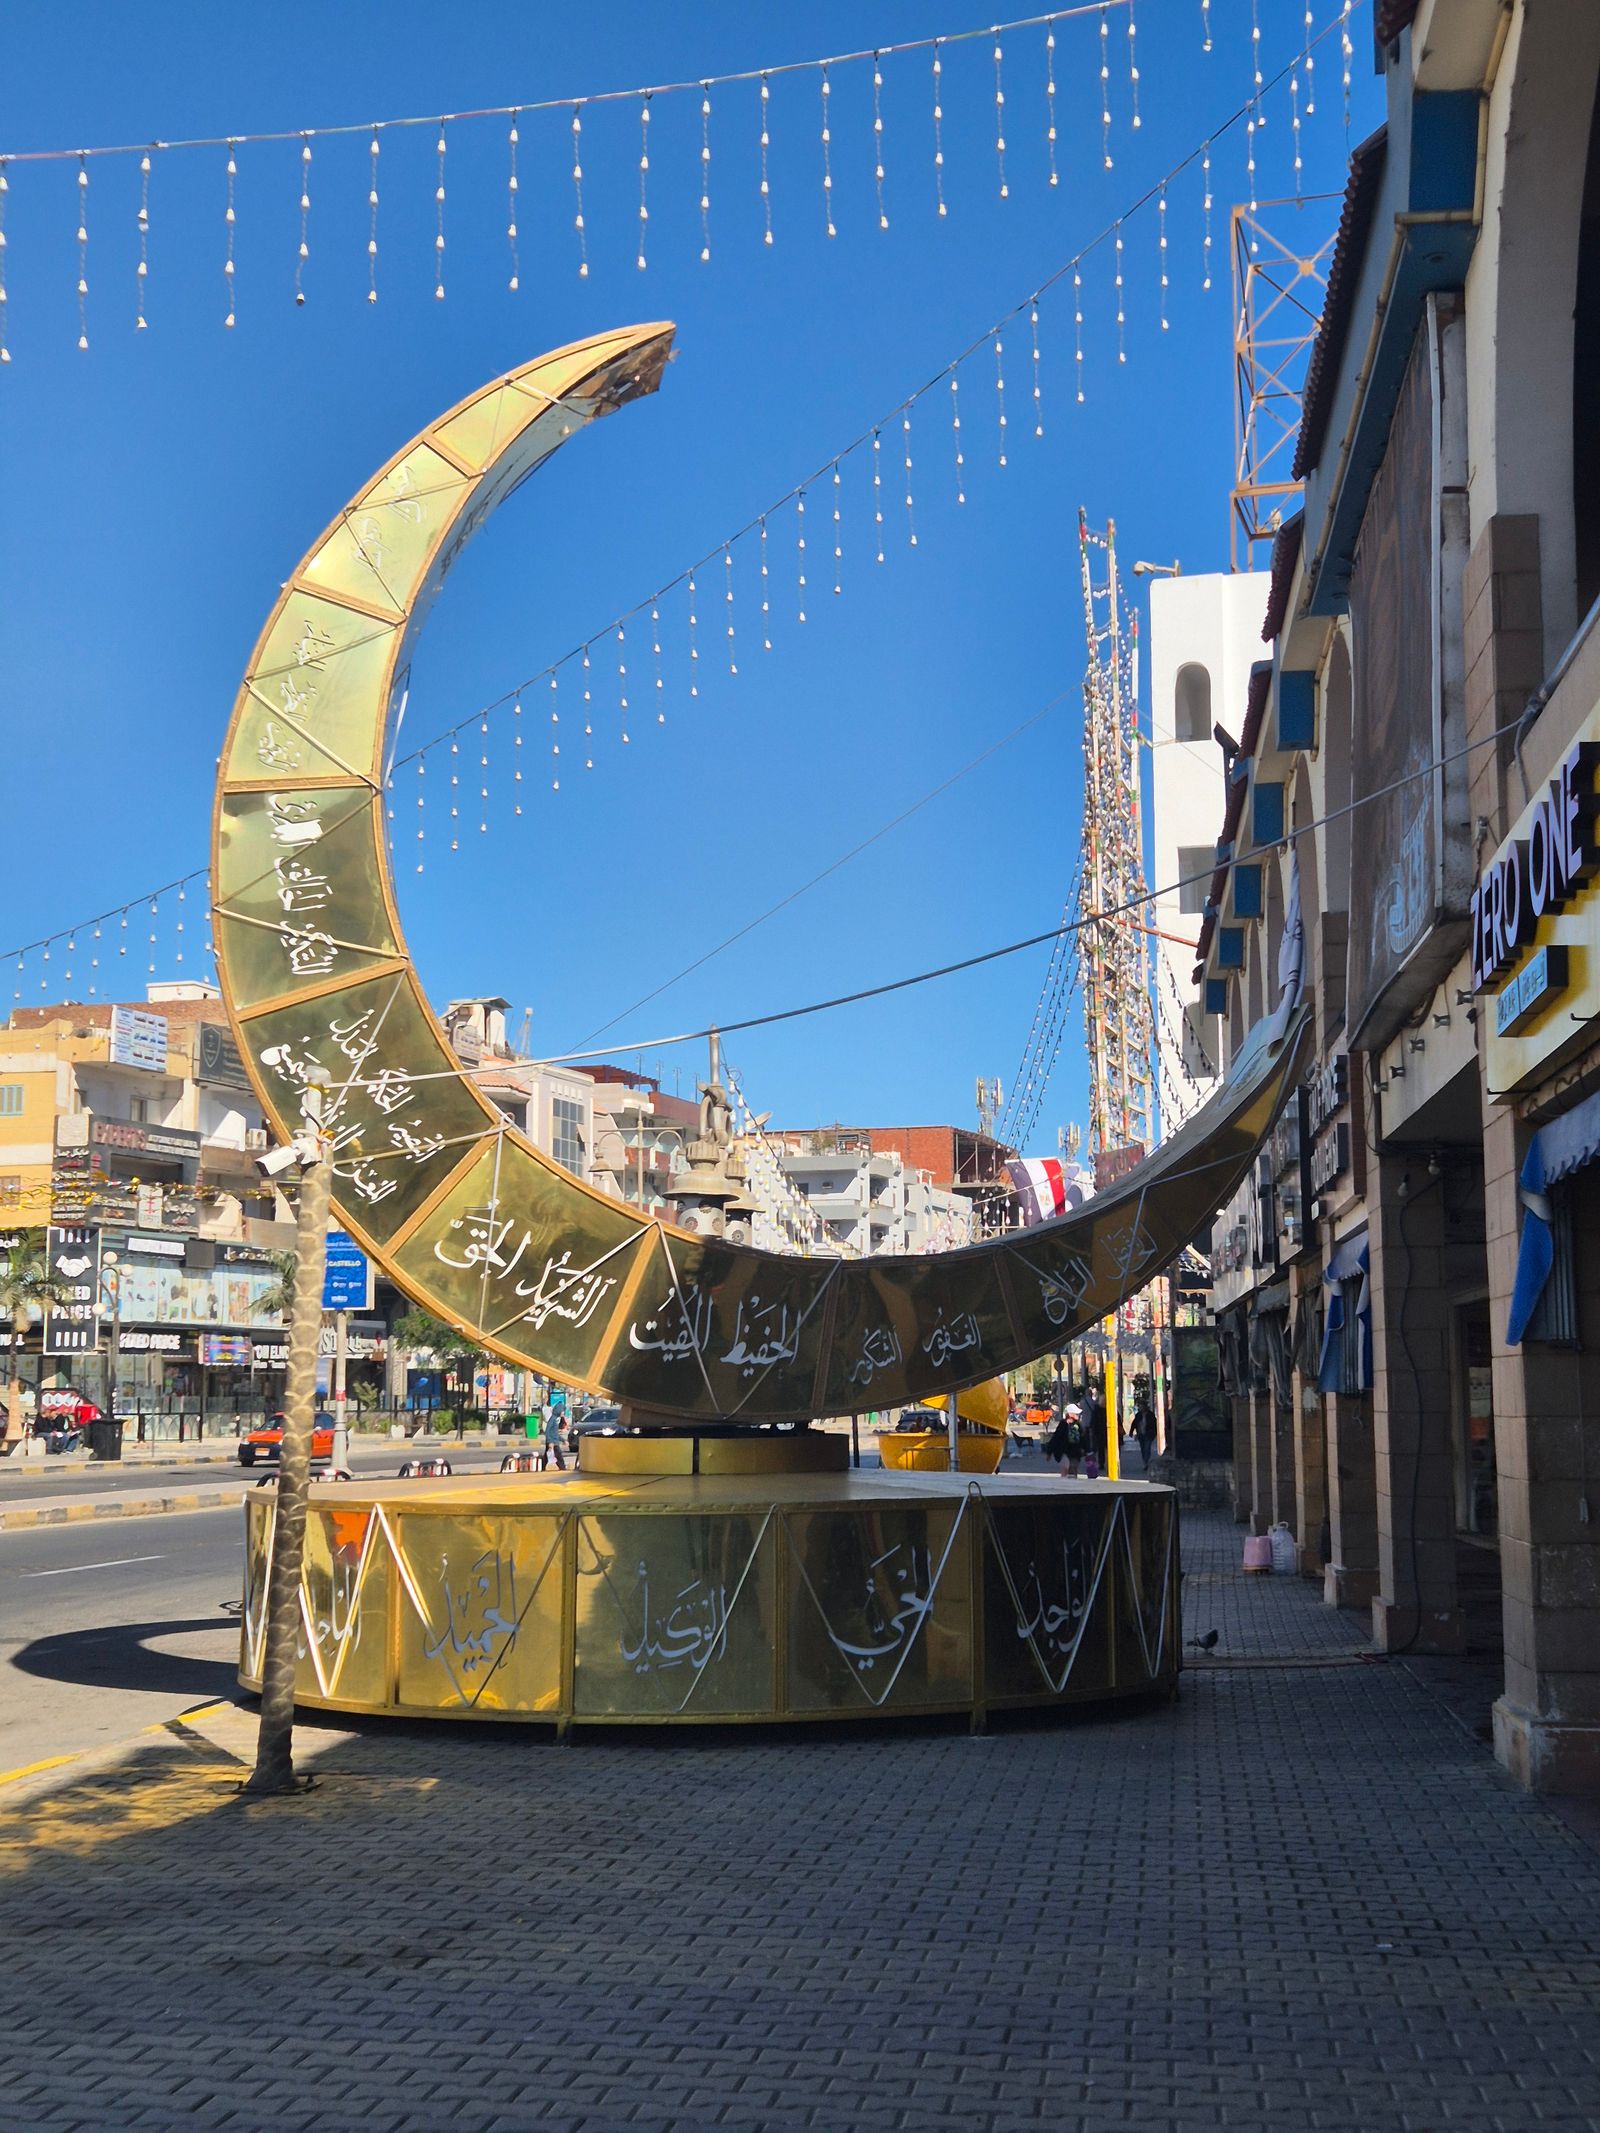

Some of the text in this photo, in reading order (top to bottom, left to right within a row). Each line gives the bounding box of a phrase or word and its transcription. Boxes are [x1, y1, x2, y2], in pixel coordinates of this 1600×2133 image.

[1470, 742, 1582, 995] ZERO ONE
[52, 1304, 92, 1320] PRICE
